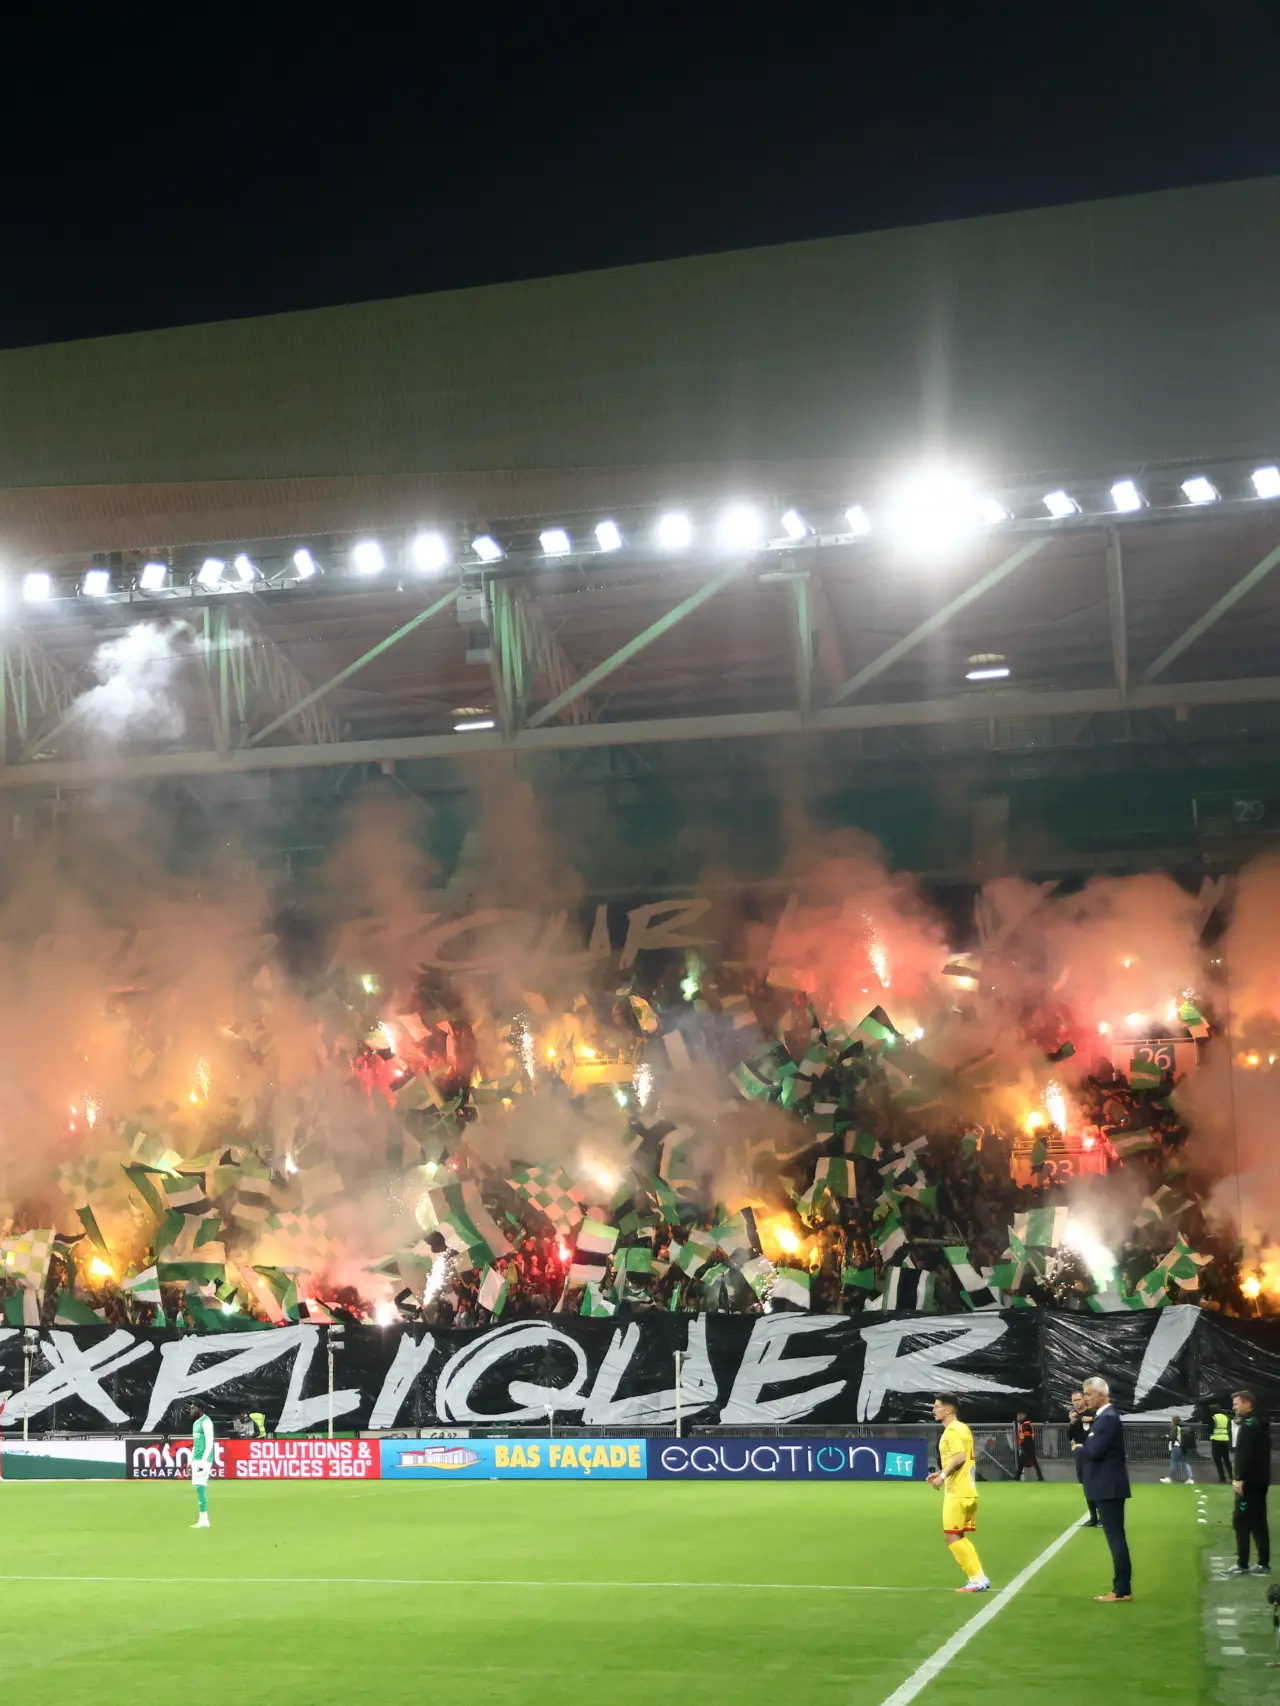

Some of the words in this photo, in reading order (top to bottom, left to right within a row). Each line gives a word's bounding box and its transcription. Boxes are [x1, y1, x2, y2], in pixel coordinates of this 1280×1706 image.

[1233, 799, 1265, 823] 29
[249, 1441, 352, 1460] SOLUTIONS
[357, 1441, 373, 1460] &
[494, 1444, 541, 1468] BAS
[549, 1445, 641, 1474] FAÇADE
[236, 1459, 324, 1478] SERVICES
[328, 1459, 372, 1478] 360°
